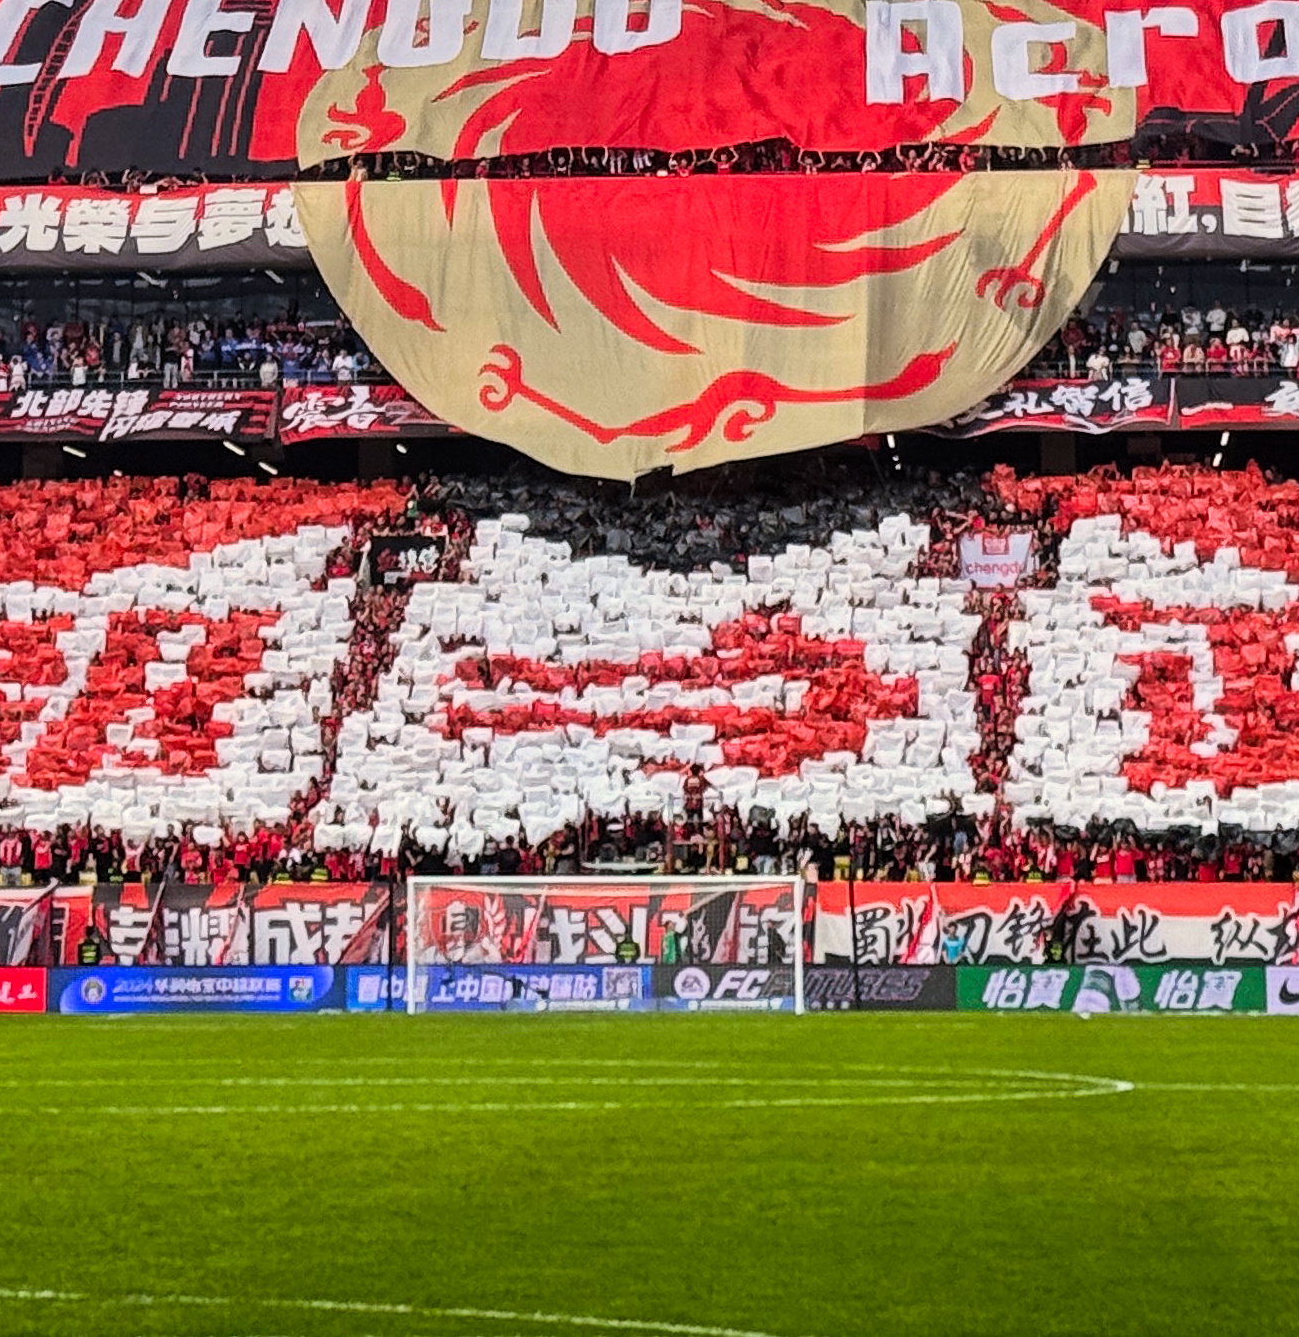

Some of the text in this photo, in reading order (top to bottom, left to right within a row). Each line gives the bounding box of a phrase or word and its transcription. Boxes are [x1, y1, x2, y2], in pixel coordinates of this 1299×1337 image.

[965, 560, 1024, 577] chengd
[712, 969, 770, 1000] FC
[1154, 969, 1242, 1010] 怡寶
